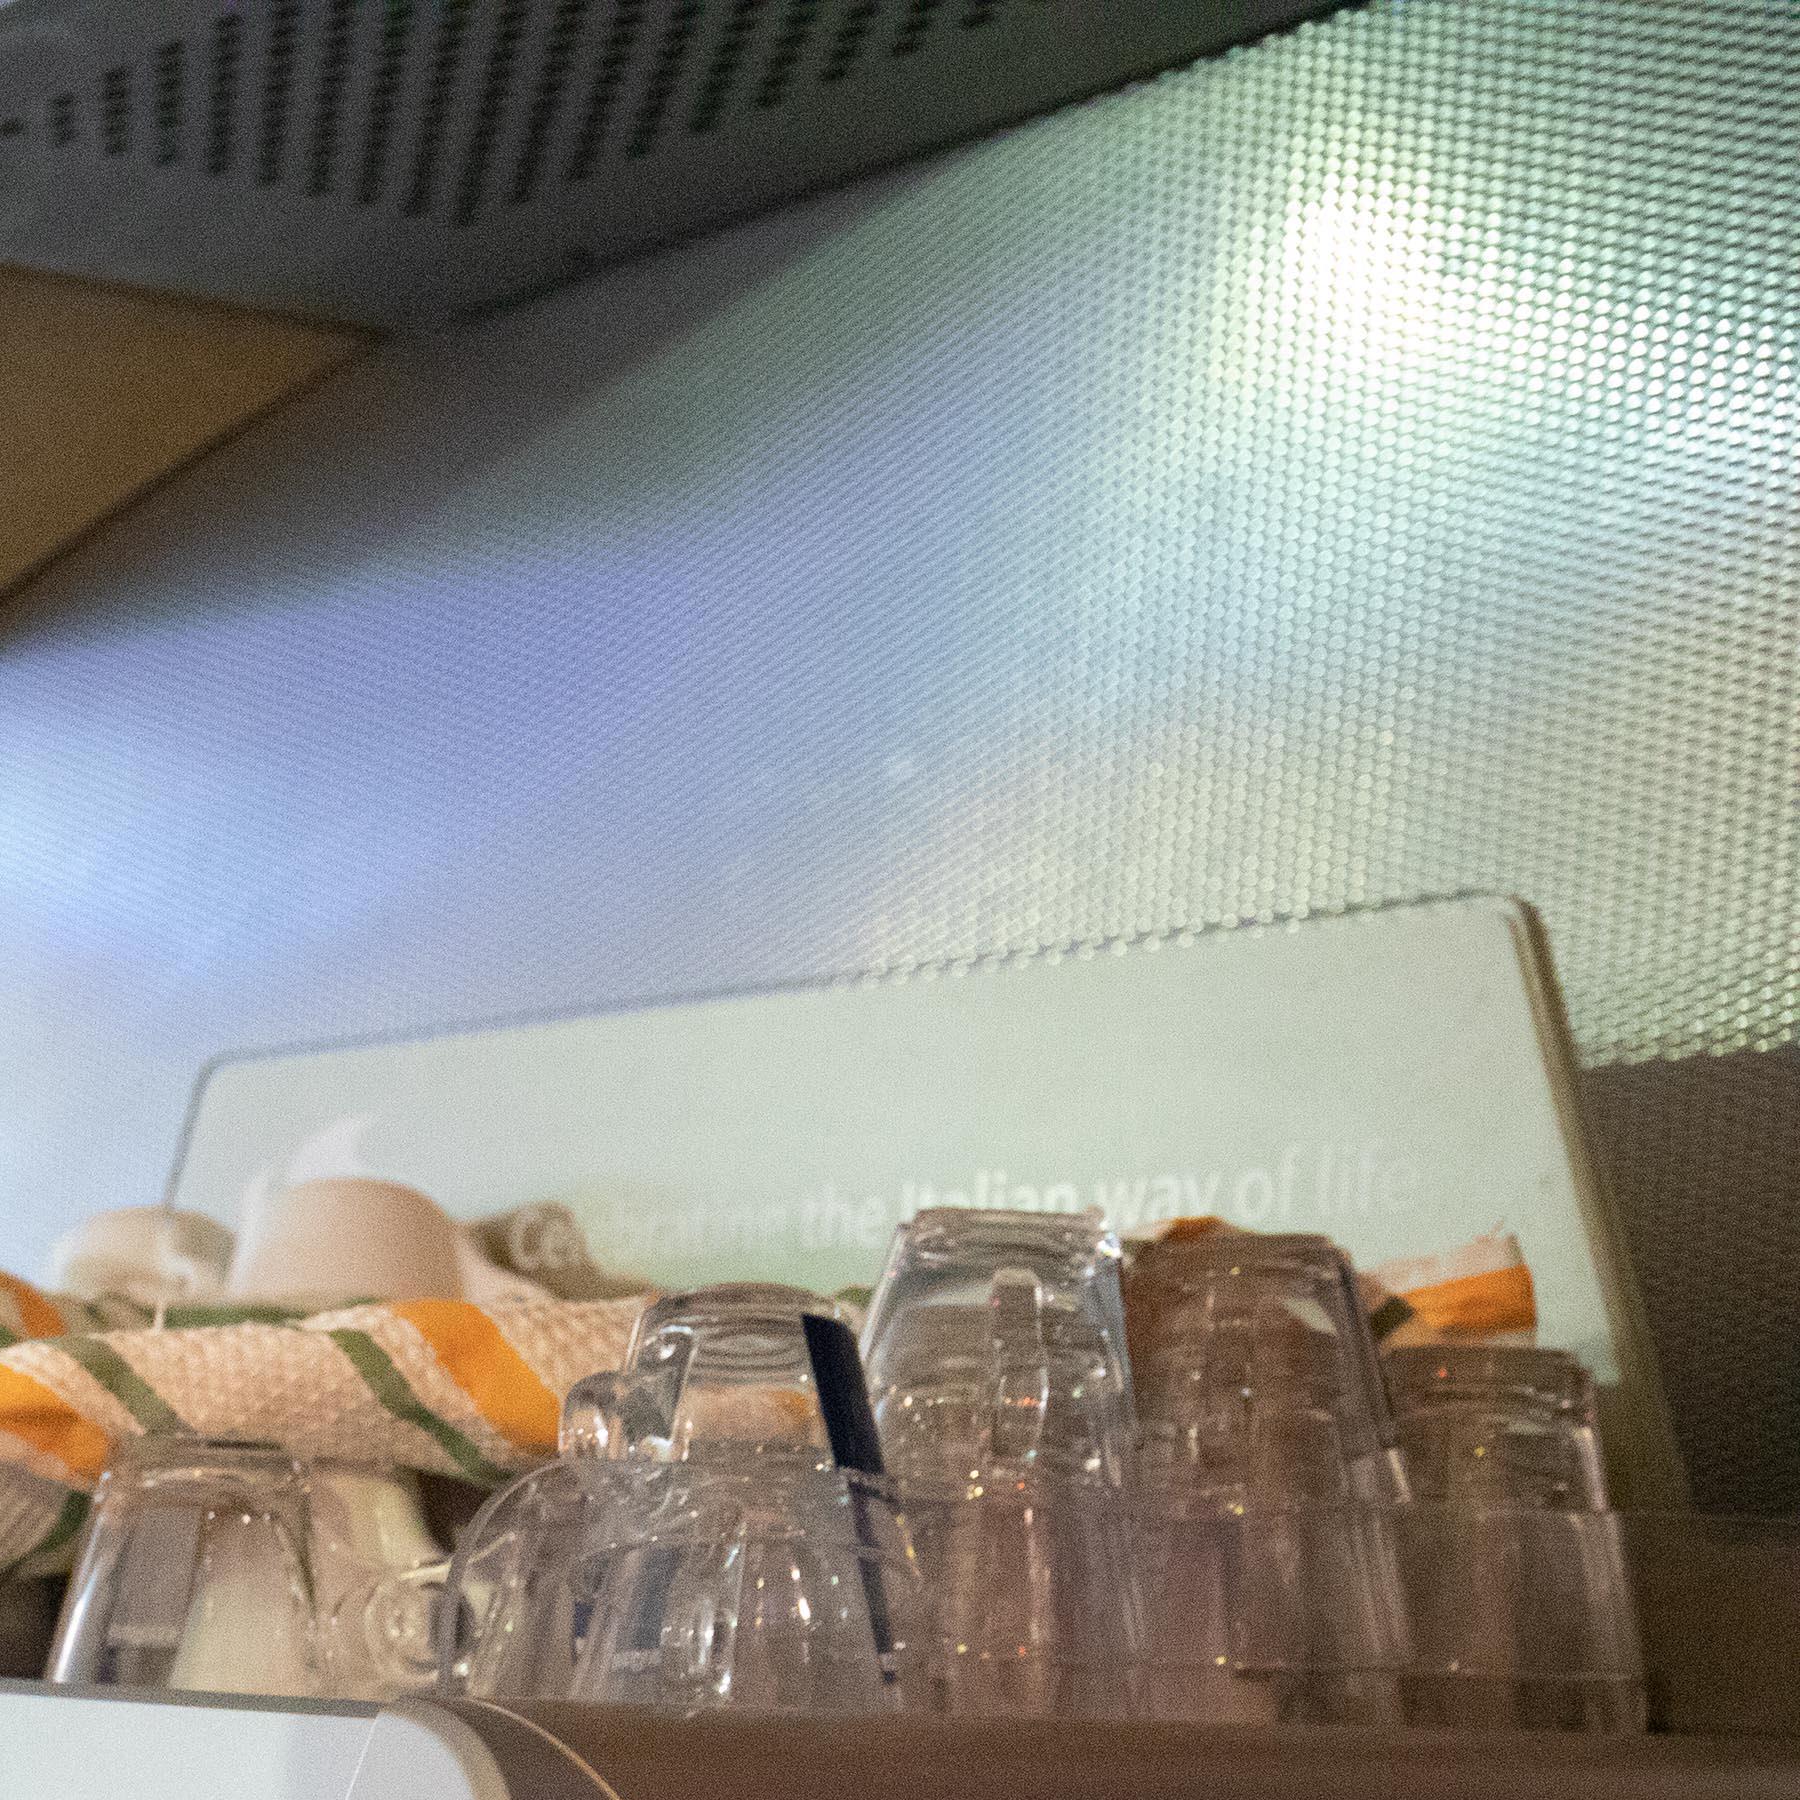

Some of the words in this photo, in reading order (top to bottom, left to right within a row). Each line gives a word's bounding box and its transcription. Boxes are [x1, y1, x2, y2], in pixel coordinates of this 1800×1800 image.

[802, 1181, 889, 1249] the
[1095, 1170, 1223, 1228] way
[1235, 1143, 1306, 1221] of
[1317, 1136, 1421, 1215] life
